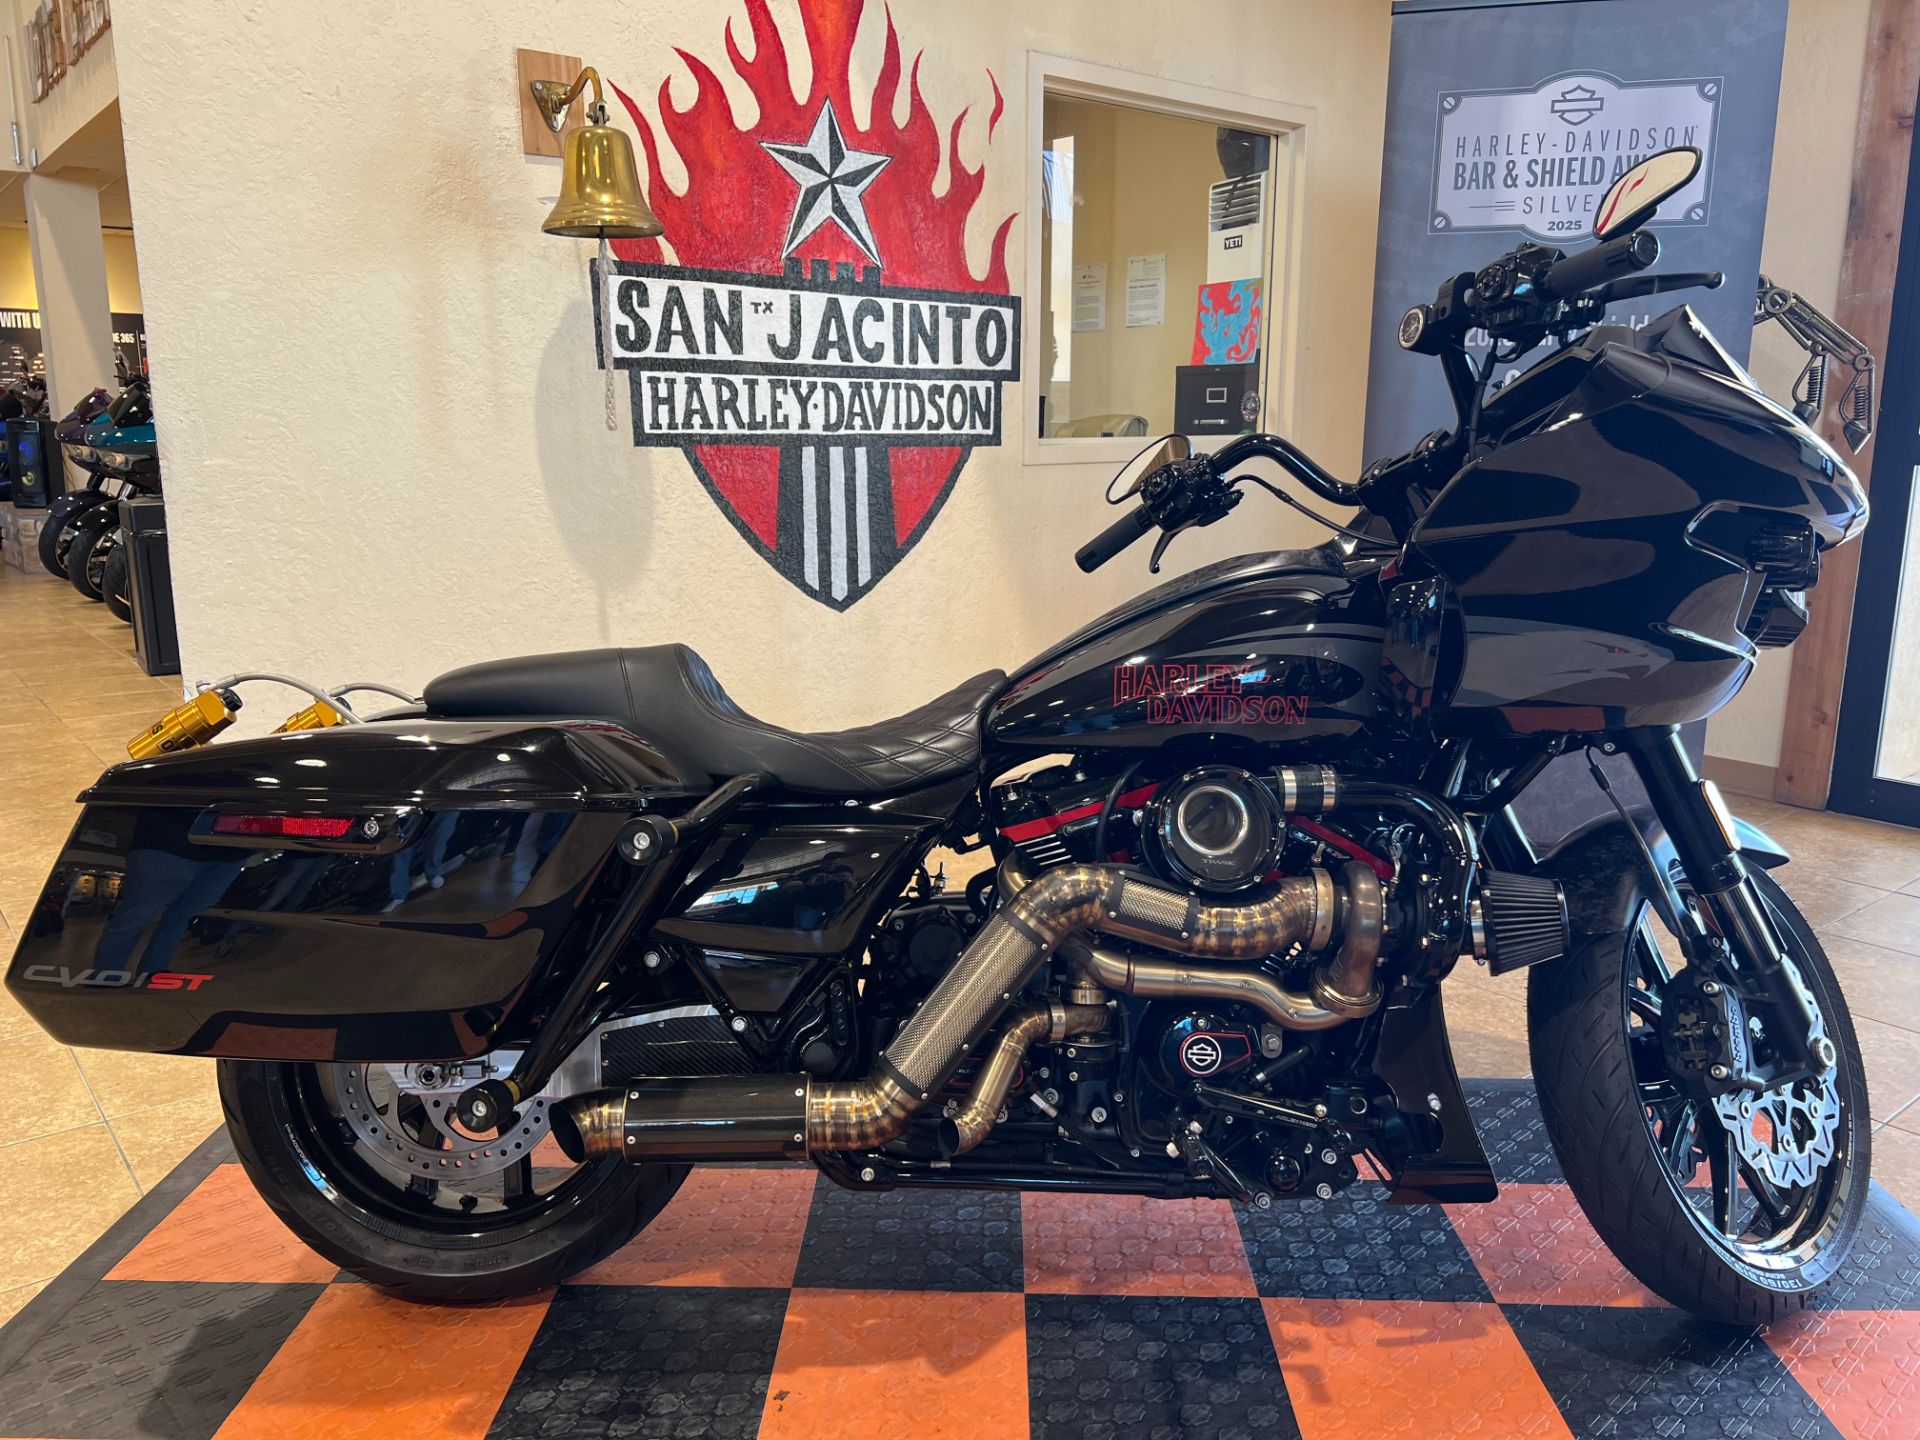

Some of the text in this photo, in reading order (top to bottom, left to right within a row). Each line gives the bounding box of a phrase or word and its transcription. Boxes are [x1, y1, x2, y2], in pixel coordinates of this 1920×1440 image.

[1453, 161, 1496, 191] BAR
[1503, 159, 1519, 189] &
[1525, 156, 1605, 189] SHIELD
[1523, 194, 1605, 214] SILVE
[1547, 220, 1582, 231] 2025
[1225, 237, 1242, 249] YETI
[750, 301, 774, 315] TX
[0, 312, 41, 330] WITH U
[616, 279, 744, 356] SAN
[768, 294, 1007, 368] JACINTO
[120, 332, 135, 343] 365
[1147, 695, 1309, 725] DAVIDSON
